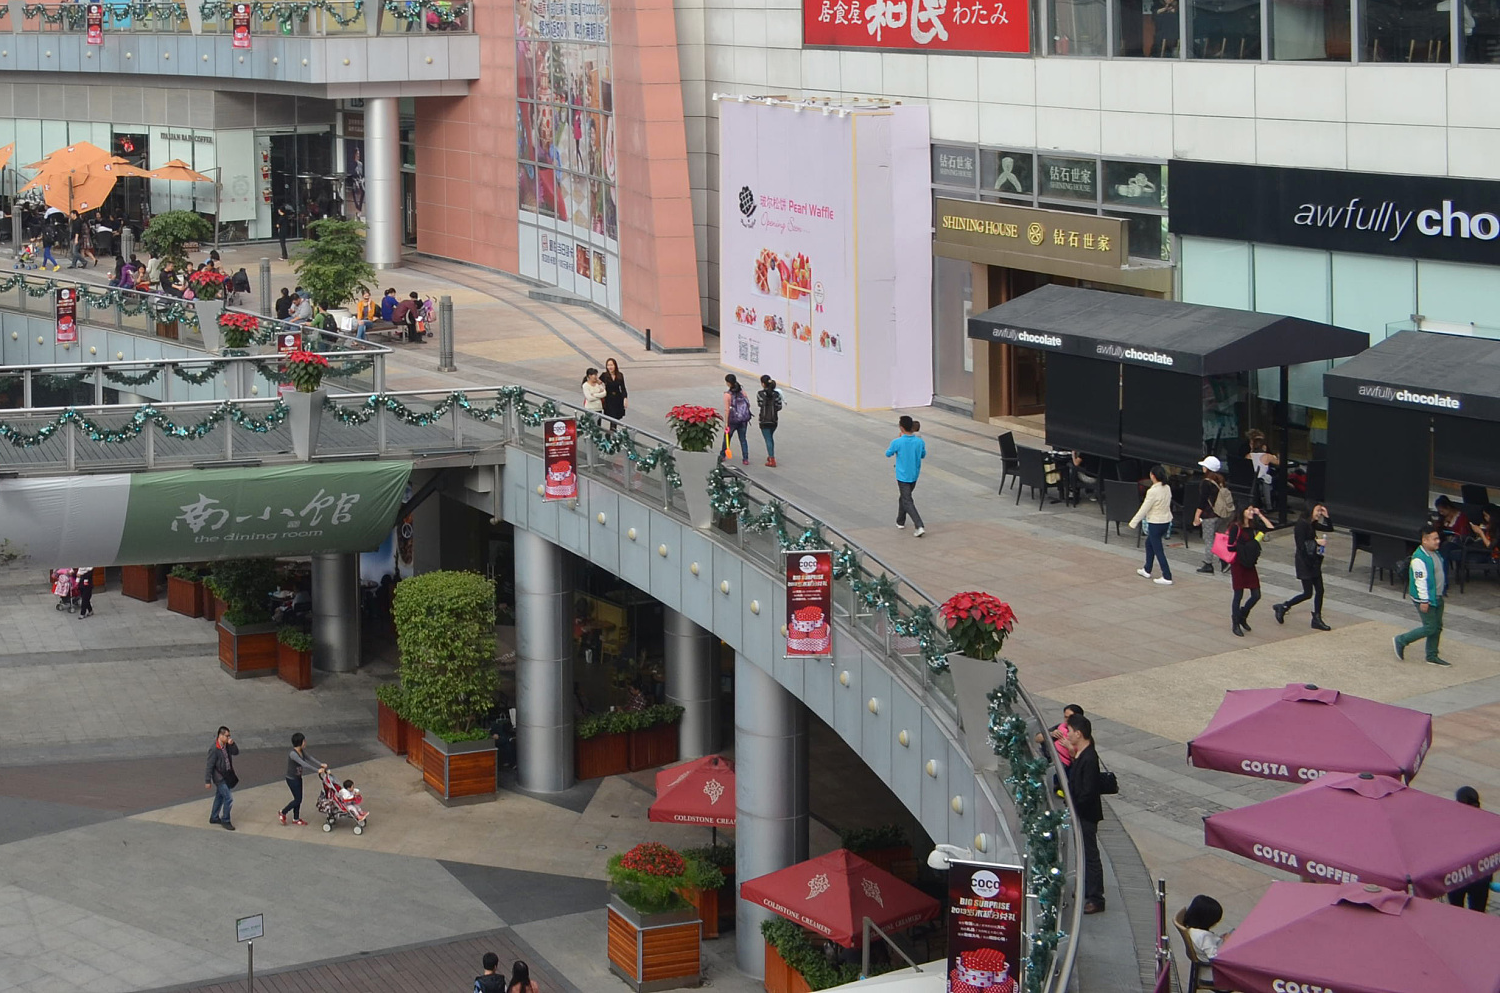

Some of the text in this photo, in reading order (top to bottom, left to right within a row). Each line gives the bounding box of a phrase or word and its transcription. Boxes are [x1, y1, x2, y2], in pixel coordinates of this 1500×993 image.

[818, 0, 862, 25] 居食屋
[953, 1, 1009, 25] わたみ
[940, 154, 973, 170] 钻石世家
[1050, 165, 1092, 184] 钻石世家
[788, 200, 808, 215] Pearl
[808, 204, 835, 220] Waffle
[942, 216, 1111, 252] SHINING HOUSE 钻石世家
[194, 529, 324, 544] the dining room
[1241, 759, 1288, 776] COSTA
[674, 814, 713, 823] COLDSTONE
[1253, 843, 1298, 867] COSTA
[1444, 864, 1473, 886] COSTA
[959, 897, 1011, 911] BIG SURPRISE
[763, 898, 832, 935] COLDSTONE CREAMERY
